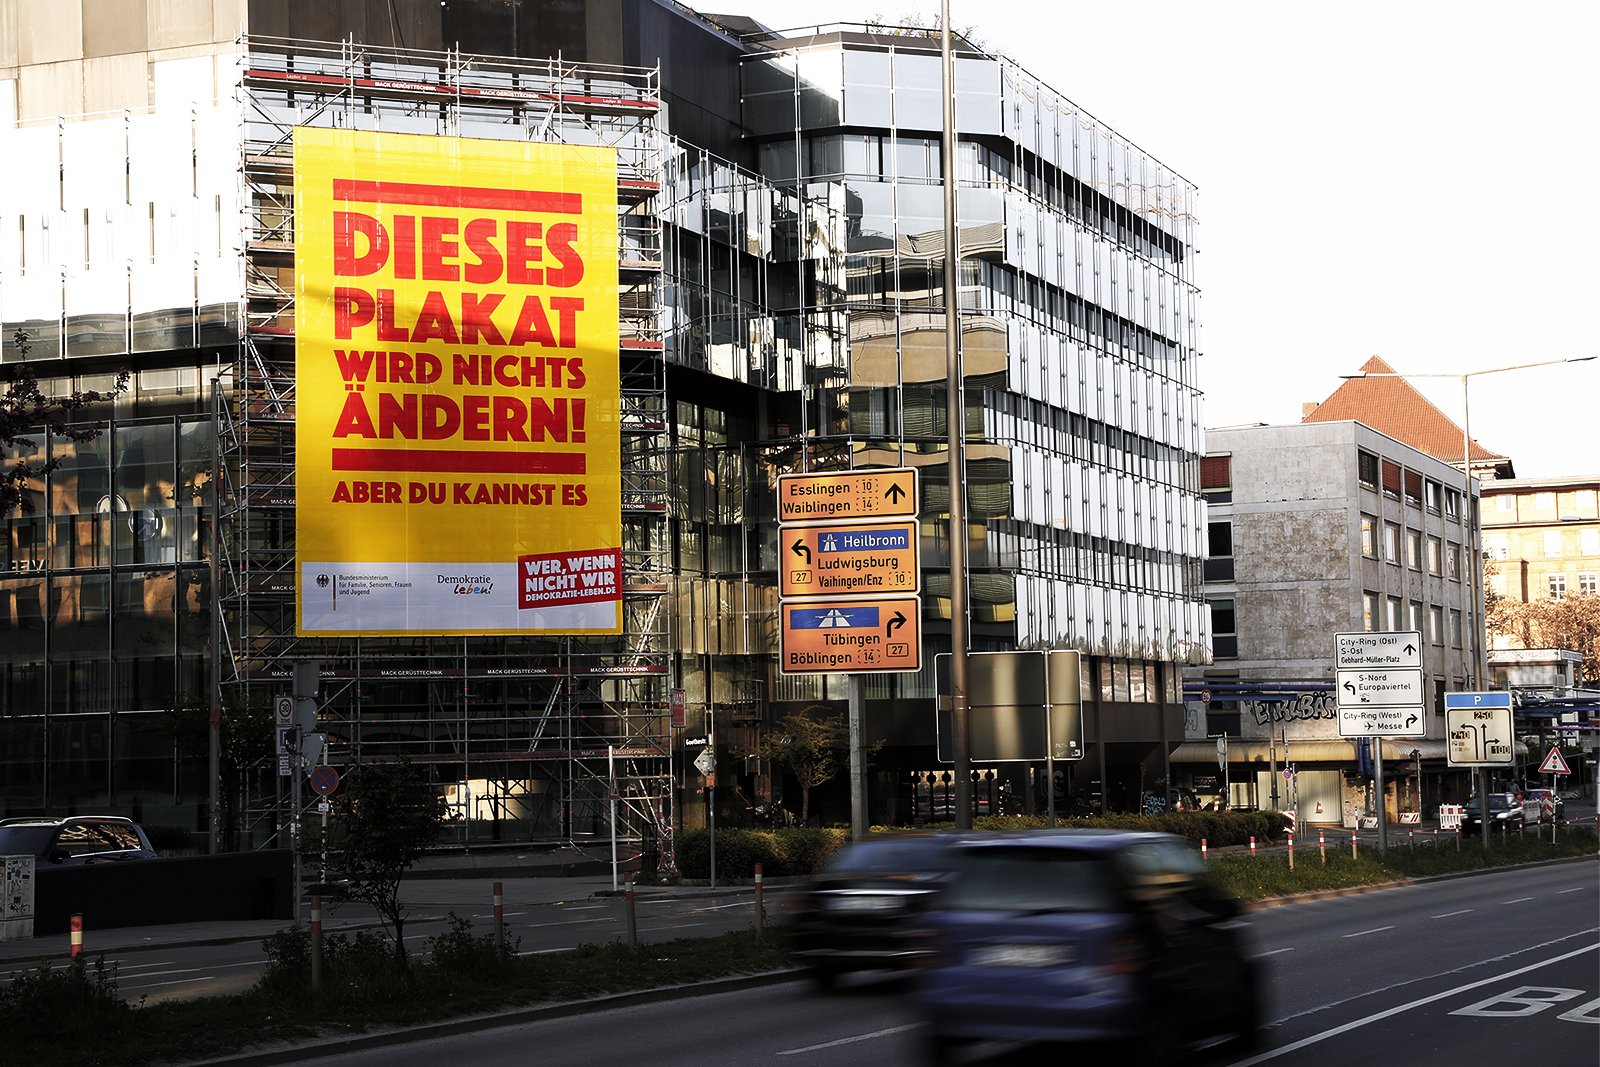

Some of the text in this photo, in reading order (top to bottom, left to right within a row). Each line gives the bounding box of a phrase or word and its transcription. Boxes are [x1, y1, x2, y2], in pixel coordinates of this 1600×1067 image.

[392, 83, 436, 91] GERÜSTTECHNIK
[496, 90, 539, 99] GERÜSTTECHNIK
[333, 211, 584, 288] DIESES
[334, 286, 584, 348] PLAKAT
[333, 350, 586, 389] WIRD NICHTS
[332, 384, 586, 443] ÄNDERN!
[332, 481, 588, 507] ABER DU KANNST ES
[790, 481, 872, 497] Esslingen 10
[783, 500, 872, 514] Waiblingen 14
[844, 534, 905, 548] Heilbronn
[524, 554, 615, 576] WER, WENN
[818, 556, 899, 571] Ludwigsburg
[437, 574, 491, 584] Demokratie
[525, 571, 615, 593] NICHT WIR
[796, 572, 807, 582] 27
[818, 573, 905, 589] Vaihingen/Enz 10
[350, 588, 370, 596] Jugend
[453, 583, 493, 595] leben!
[823, 633, 881, 647] Tübingen
[1340, 637, 1397, 647] City-Ring (Ost)
[891, 646, 903, 655] 27
[1341, 647, 1363, 655] S-Ost
[790, 651, 874, 666] Böblingen 14
[1341, 655, 1400, 664] Gebhard-Müller-Platz
[1358, 683, 1411, 692] Europaviertel
[1474, 695, 1482, 705] P
[1343, 711, 1402, 720] City-Ring (West)
[1377, 722, 1403, 730] Messe
